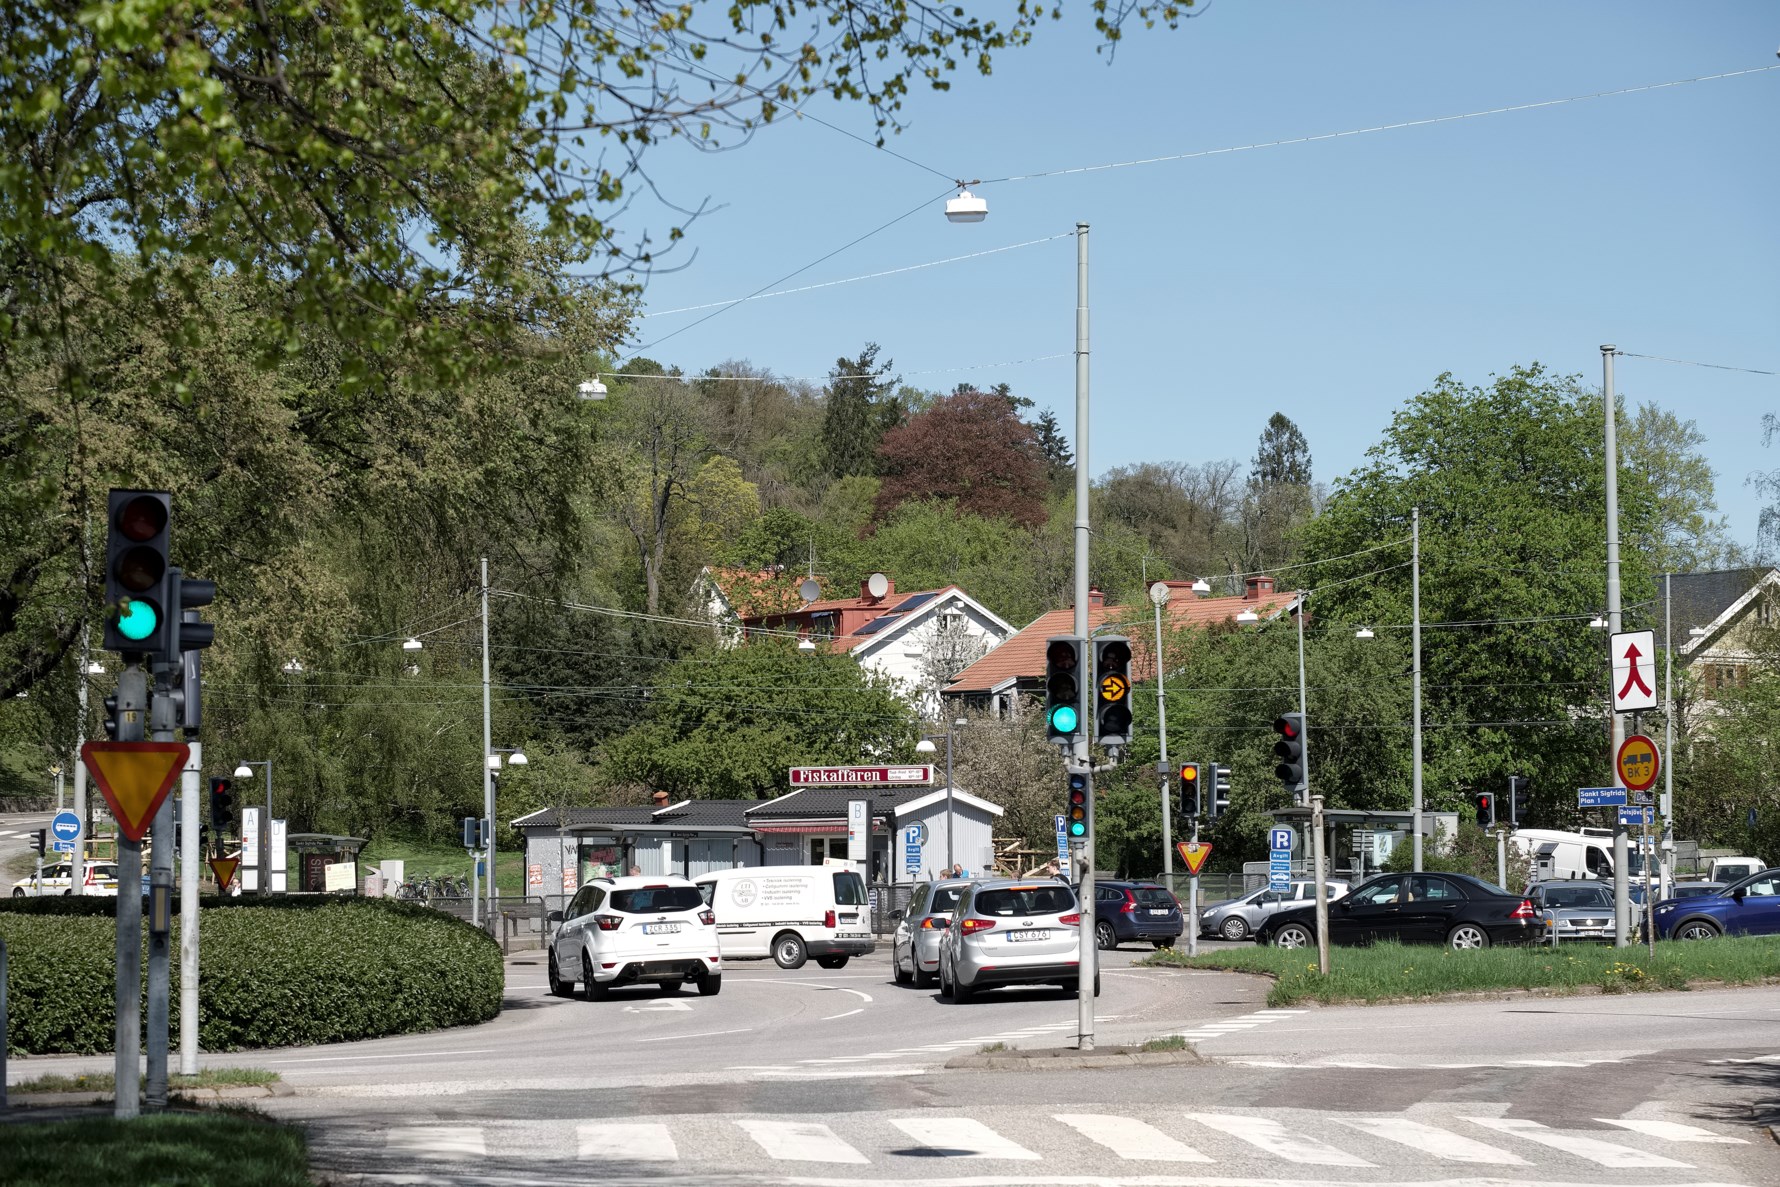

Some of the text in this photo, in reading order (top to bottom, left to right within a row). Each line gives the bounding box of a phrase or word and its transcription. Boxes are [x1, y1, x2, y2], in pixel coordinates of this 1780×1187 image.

[127, 712, 137, 722] 19
[800, 769, 881, 782] Fiskaffären
[1628, 766, 1650, 778] BK 3
[1600, 790, 1625, 798] Sigfrids
[855, 803, 862, 818] B
[247, 811, 255, 826] A
[1057, 816, 1064, 831] P
[273, 822, 281, 836] D
[909, 827, 919, 843] P
[1276, 831, 1289, 848] P
[1014, 930, 1047, 939] CSY 676
